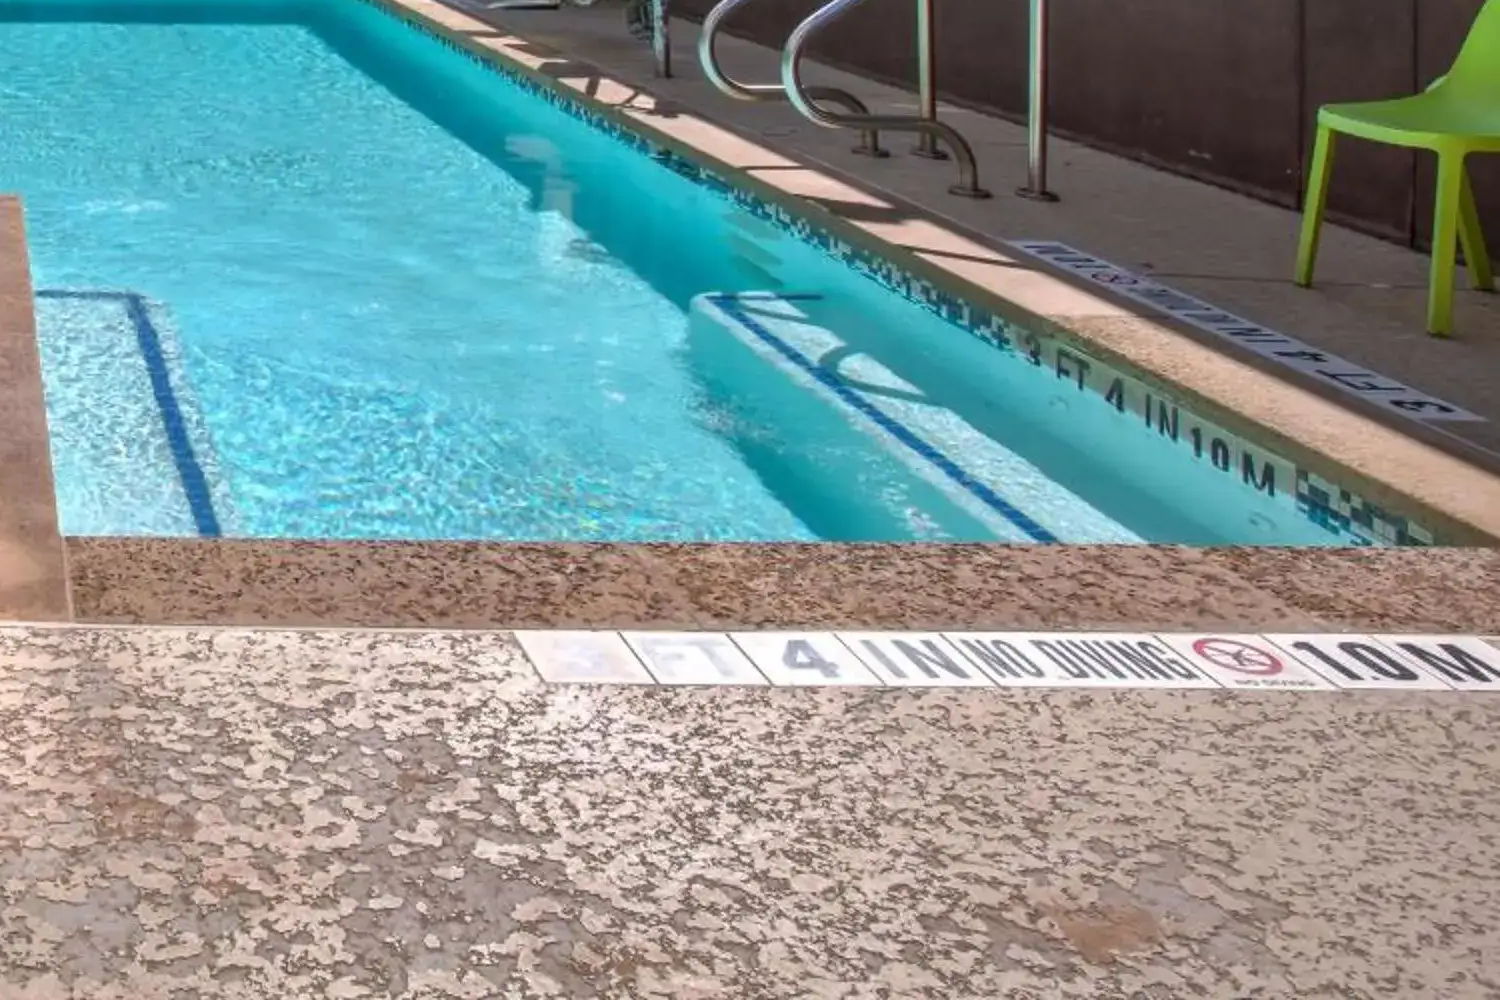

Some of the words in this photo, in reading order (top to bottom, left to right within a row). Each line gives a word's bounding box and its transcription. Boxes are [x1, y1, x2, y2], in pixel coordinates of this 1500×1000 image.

[1056, 347, 1091, 391] FT
[1104, 376, 1125, 413] 4
[1145, 394, 1180, 443] IN
[1315, 369, 1406, 391] FT
[641, 638, 737, 678] FT
[782, 638, 842, 679] 4
[858, 639, 972, 679] IN
[959, 639, 1046, 679] NO
[1029, 639, 1200, 680] DIVING
[1396, 642, 1500, 683] M
